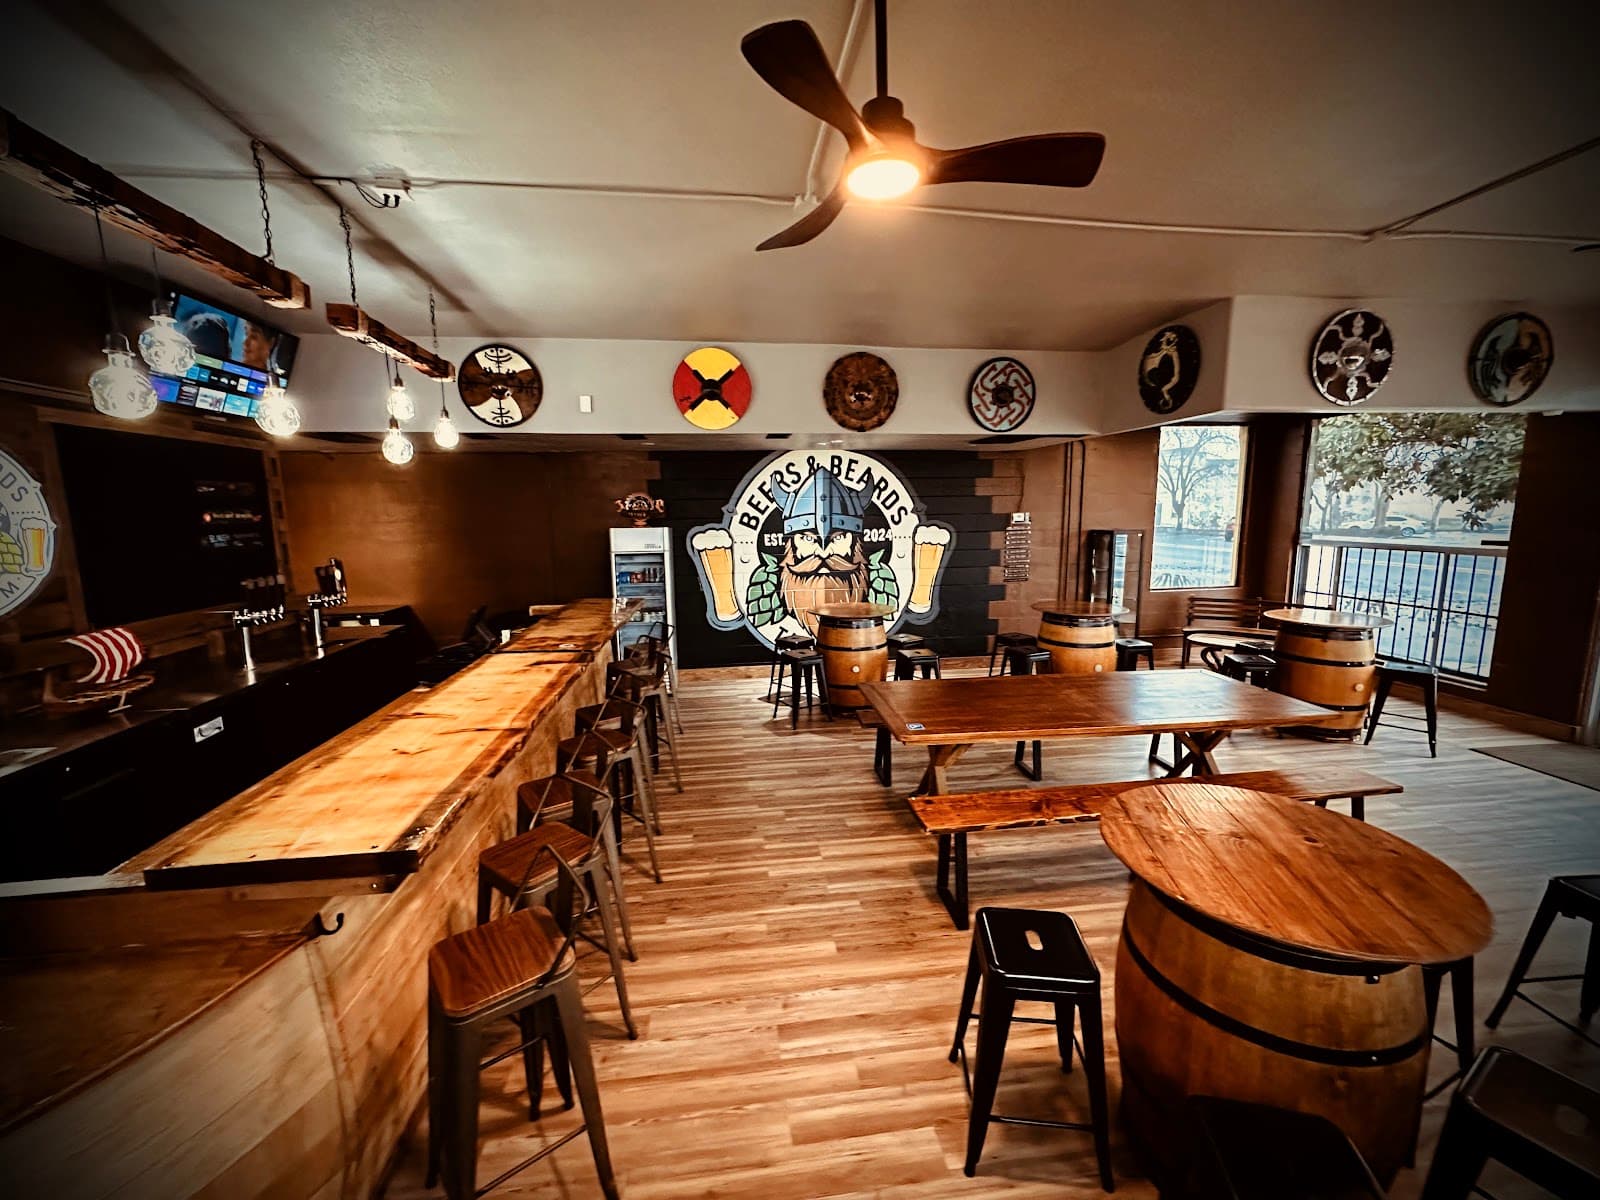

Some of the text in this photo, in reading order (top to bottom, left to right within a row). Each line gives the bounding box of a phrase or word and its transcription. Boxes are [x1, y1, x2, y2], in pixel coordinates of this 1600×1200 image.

[739, 455, 908, 531] BEERS & BEARDS
[763, 528, 893, 547] EST. 2024
